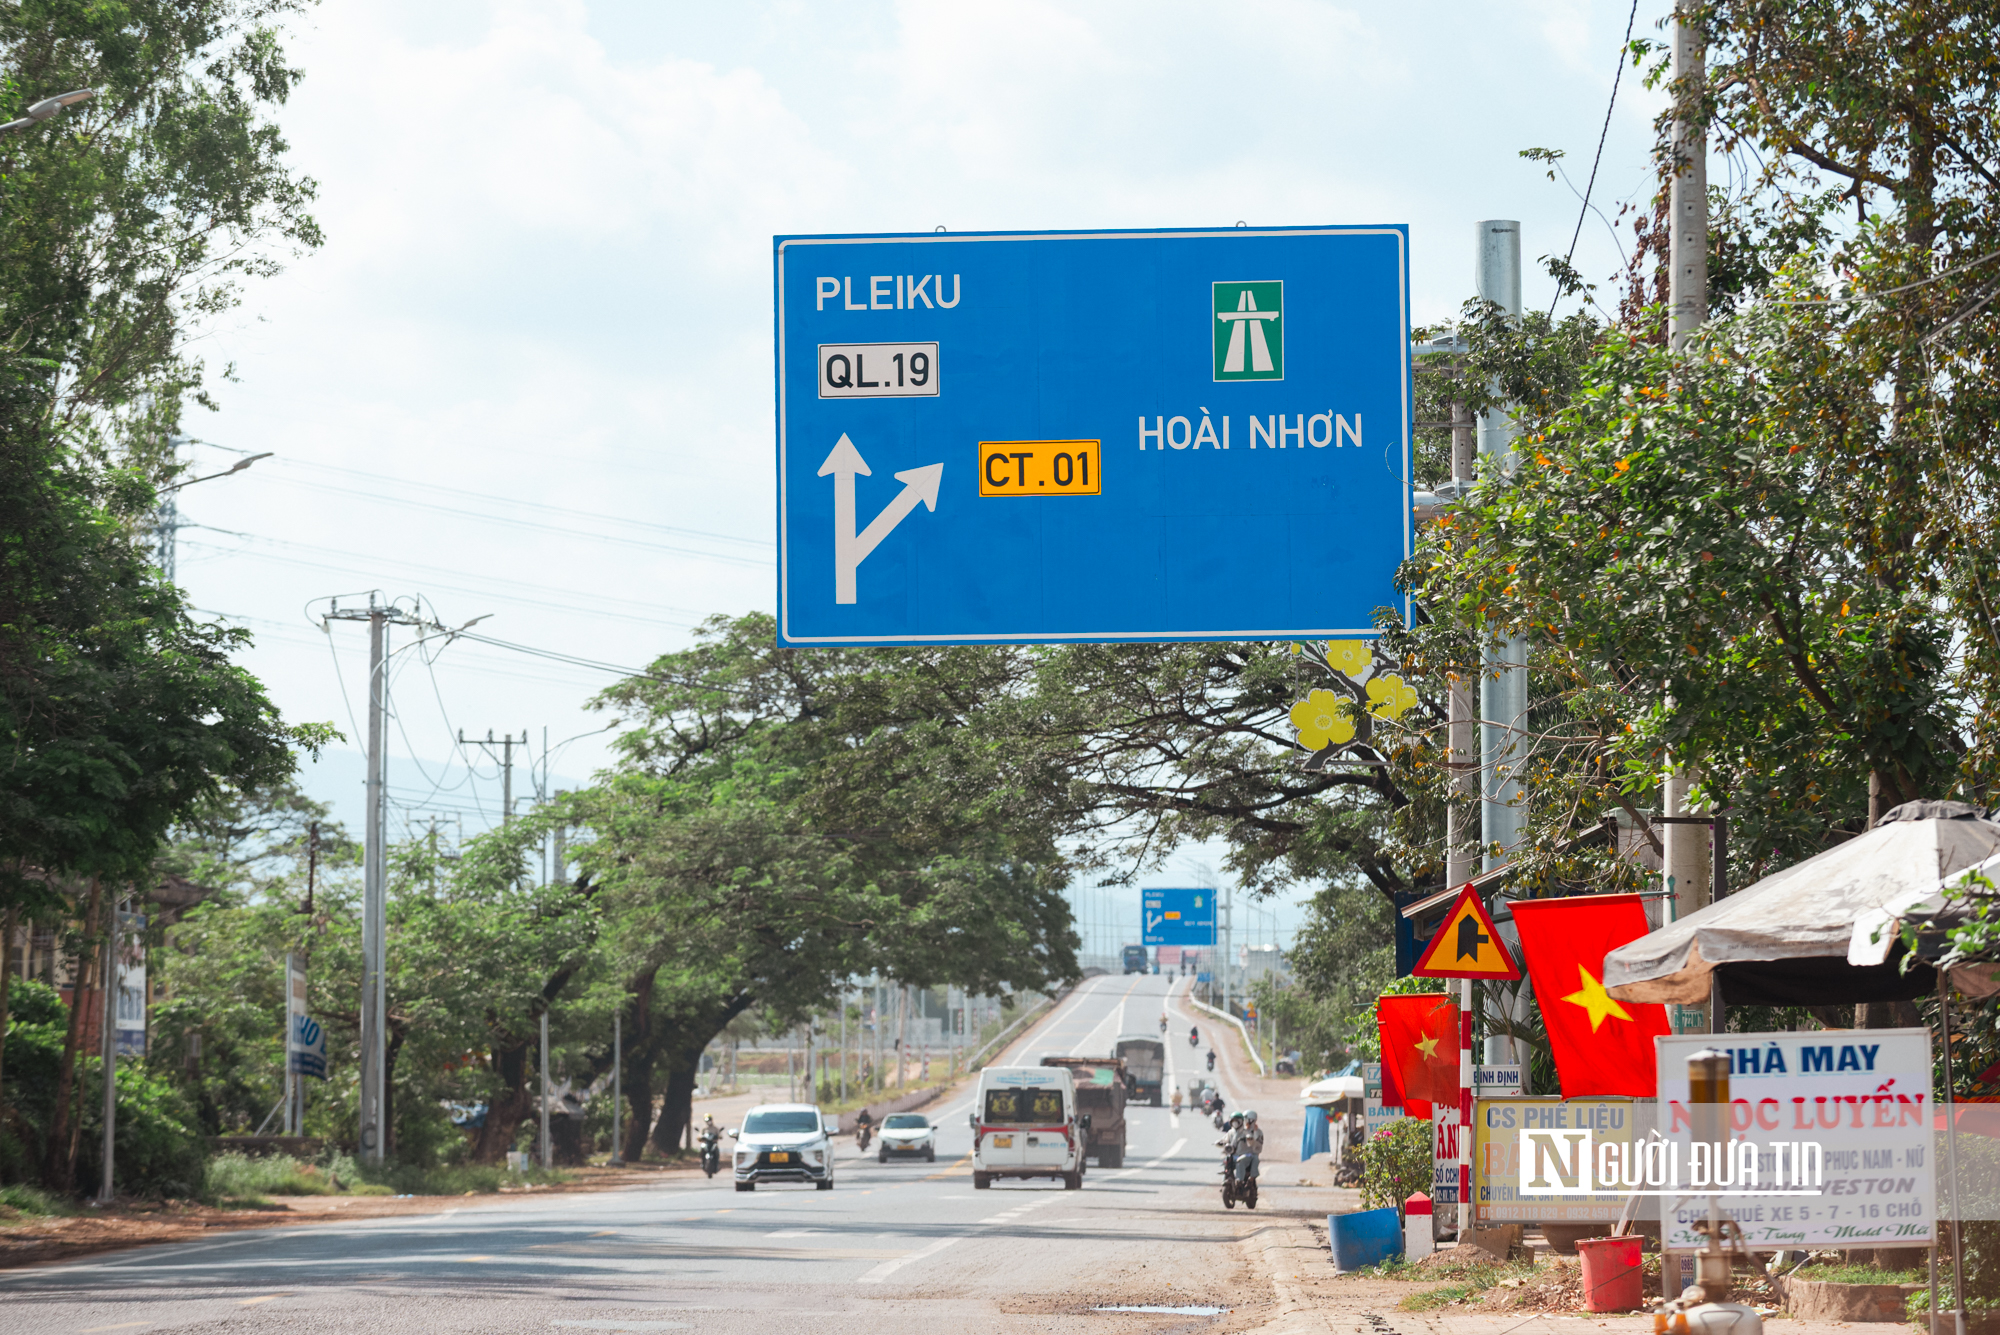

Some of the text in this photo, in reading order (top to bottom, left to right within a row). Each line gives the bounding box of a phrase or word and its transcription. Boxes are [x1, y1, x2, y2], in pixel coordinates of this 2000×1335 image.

[816, 274, 961, 311] PLEIKU
[825, 352, 930, 389] QL.19
[1139, 406, 1362, 450] HOÀI NHƠN
[985, 451, 1090, 488] CT.01
[1800, 1044, 1880, 1073] MAY
[1497, 1071, 1519, 1086] ĐỊNH
[1486, 1100, 1624, 1134] CS PHẾ LIỆU
[1668, 1078, 1926, 1141] NỌC LUYẾN
[1824, 1150, 1859, 1175] PHỤC
[1863, 1149, 1893, 1170] NAM
[1480, 1183, 1513, 1201] CHUYÊN
[1496, 1206, 1519, 1219] 0912
[1522, 1207, 1538, 1219] 118
[1541, 1207, 1558, 1219] 629
[1566, 1207, 1590, 1219] 0932
[1592, 1207, 1608, 1219] 459
[1770, 1206, 1793, 1222] XE
[1800, 1206, 1810, 1220] 5
[1828, 1205, 1839, 1219] 7
[1859, 1204, 1880, 1218] 16
